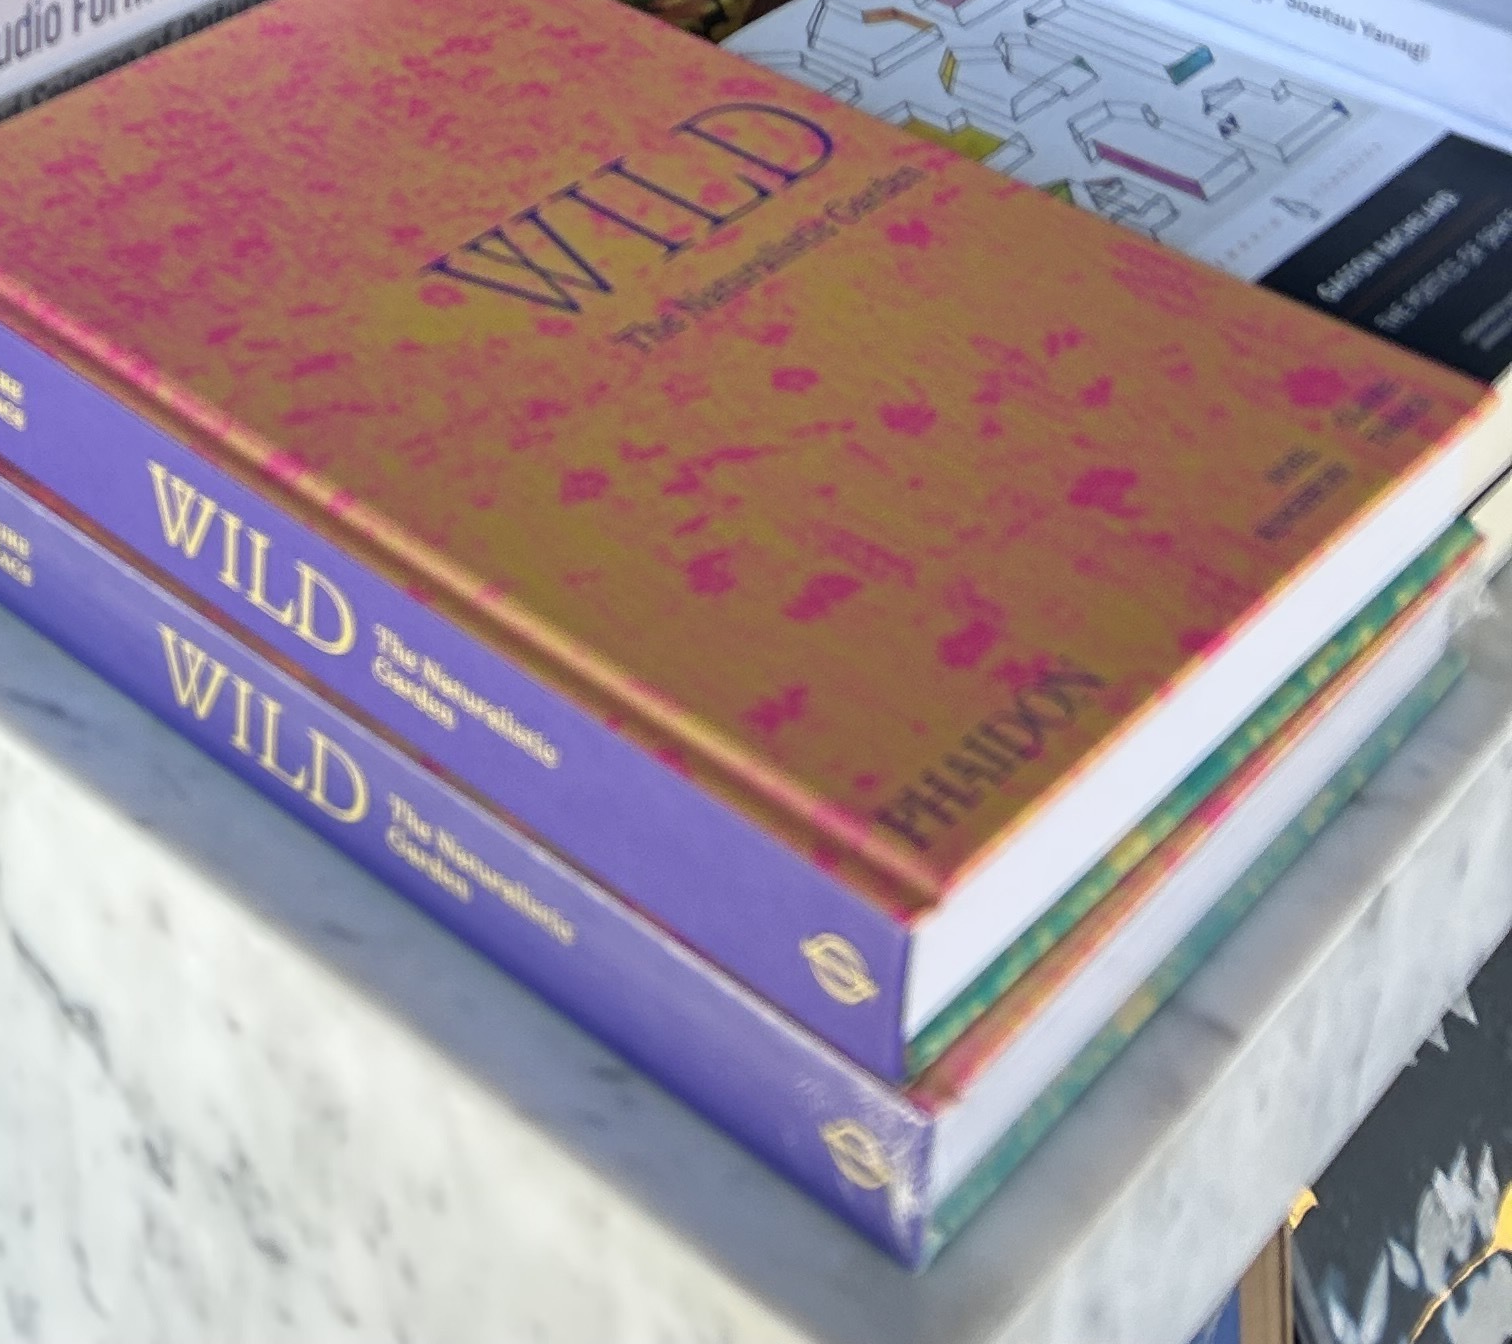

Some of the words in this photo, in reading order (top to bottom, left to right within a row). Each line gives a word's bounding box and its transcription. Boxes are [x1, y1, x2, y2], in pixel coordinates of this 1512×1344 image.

[1356, 16, 1431, 63] Yanagi
[421, 102, 833, 314] WILD
[146, 458, 358, 657] WILD
[156, 622, 370, 825] WILD
[369, 655, 458, 732] Garden
[371, 622, 419, 673] The
[421, 655, 561, 770] Naturalistic
[880, 652, 1108, 850] PHAIDON
[385, 826, 474, 903] Garden
[388, 792, 433, 844] The
[435, 826, 577, 948] Naturalistic
